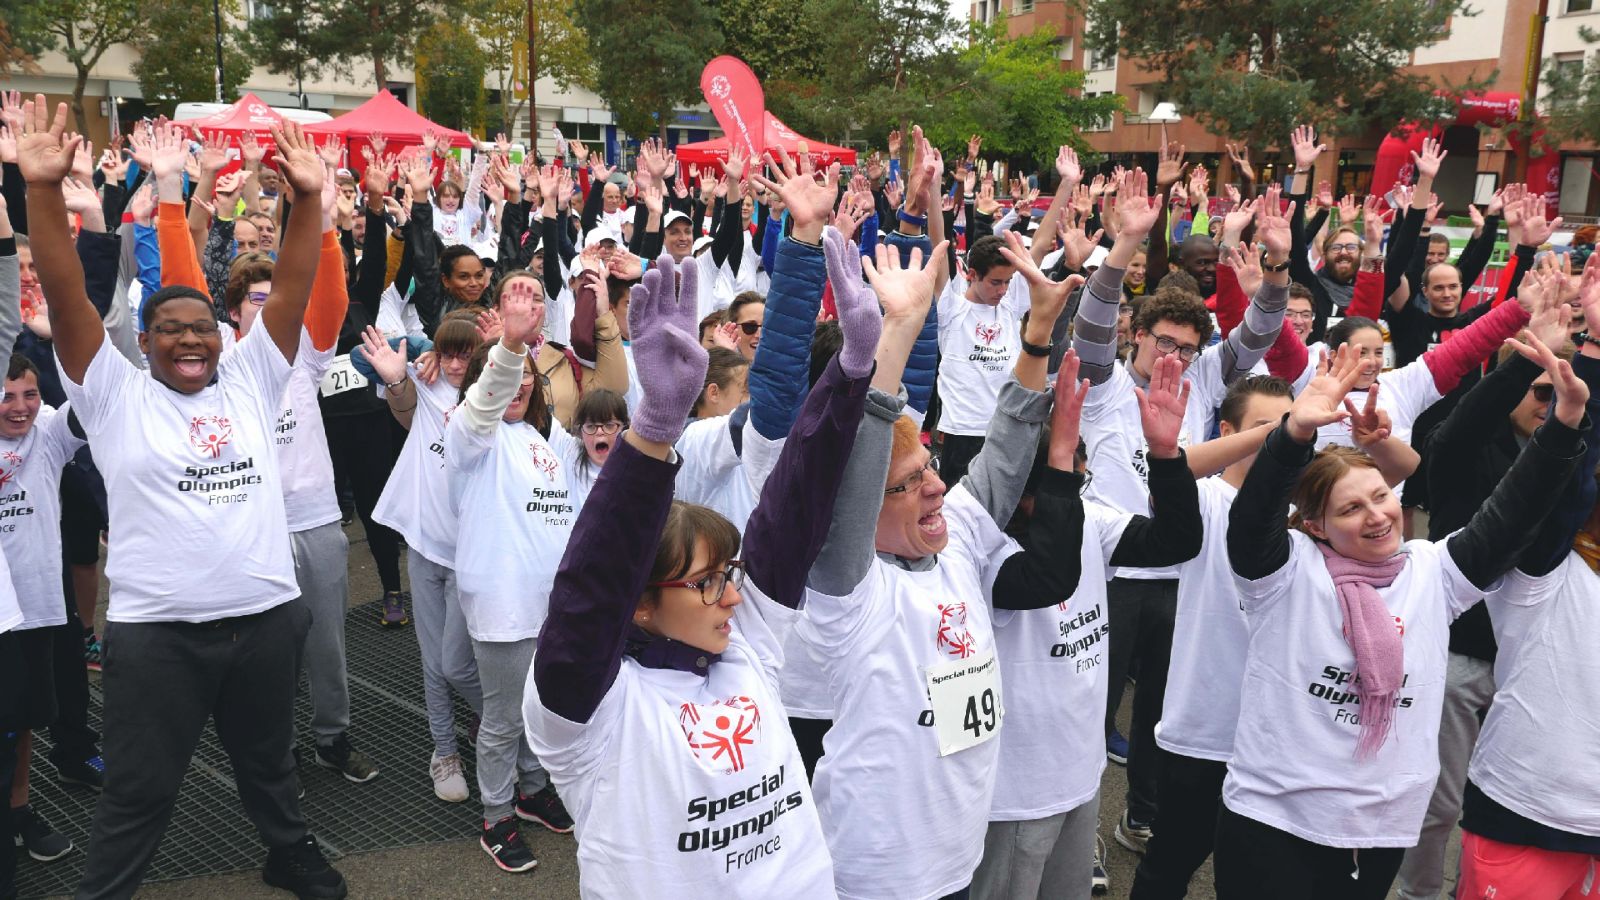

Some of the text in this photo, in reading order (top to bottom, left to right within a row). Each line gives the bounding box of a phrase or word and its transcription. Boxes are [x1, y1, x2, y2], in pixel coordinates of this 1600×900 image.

[974, 345, 1006, 353] Speal
[332, 370, 360, 390] 27 3
[184, 457, 254, 478] Special
[178, 474, 262, 492] Olympics
[533, 487, 568, 499] Special
[0, 491, 26, 505] cial
[208, 493, 248, 505] France
[0, 506, 34, 520] pics
[1050, 623, 1109, 659] Olympis
[932, 670, 965, 684] Special
[967, 658, 995, 674] Olymp
[1076, 653, 1101, 674] Fanc
[1322, 665, 1408, 688] Spel
[1308, 683, 1414, 708] Olymcs
[963, 688, 995, 737] 49
[1334, 709, 1362, 726] Fra
[687, 765, 785, 822] Special
[677, 791, 803, 853] Olympics
[725, 835, 782, 874] France
